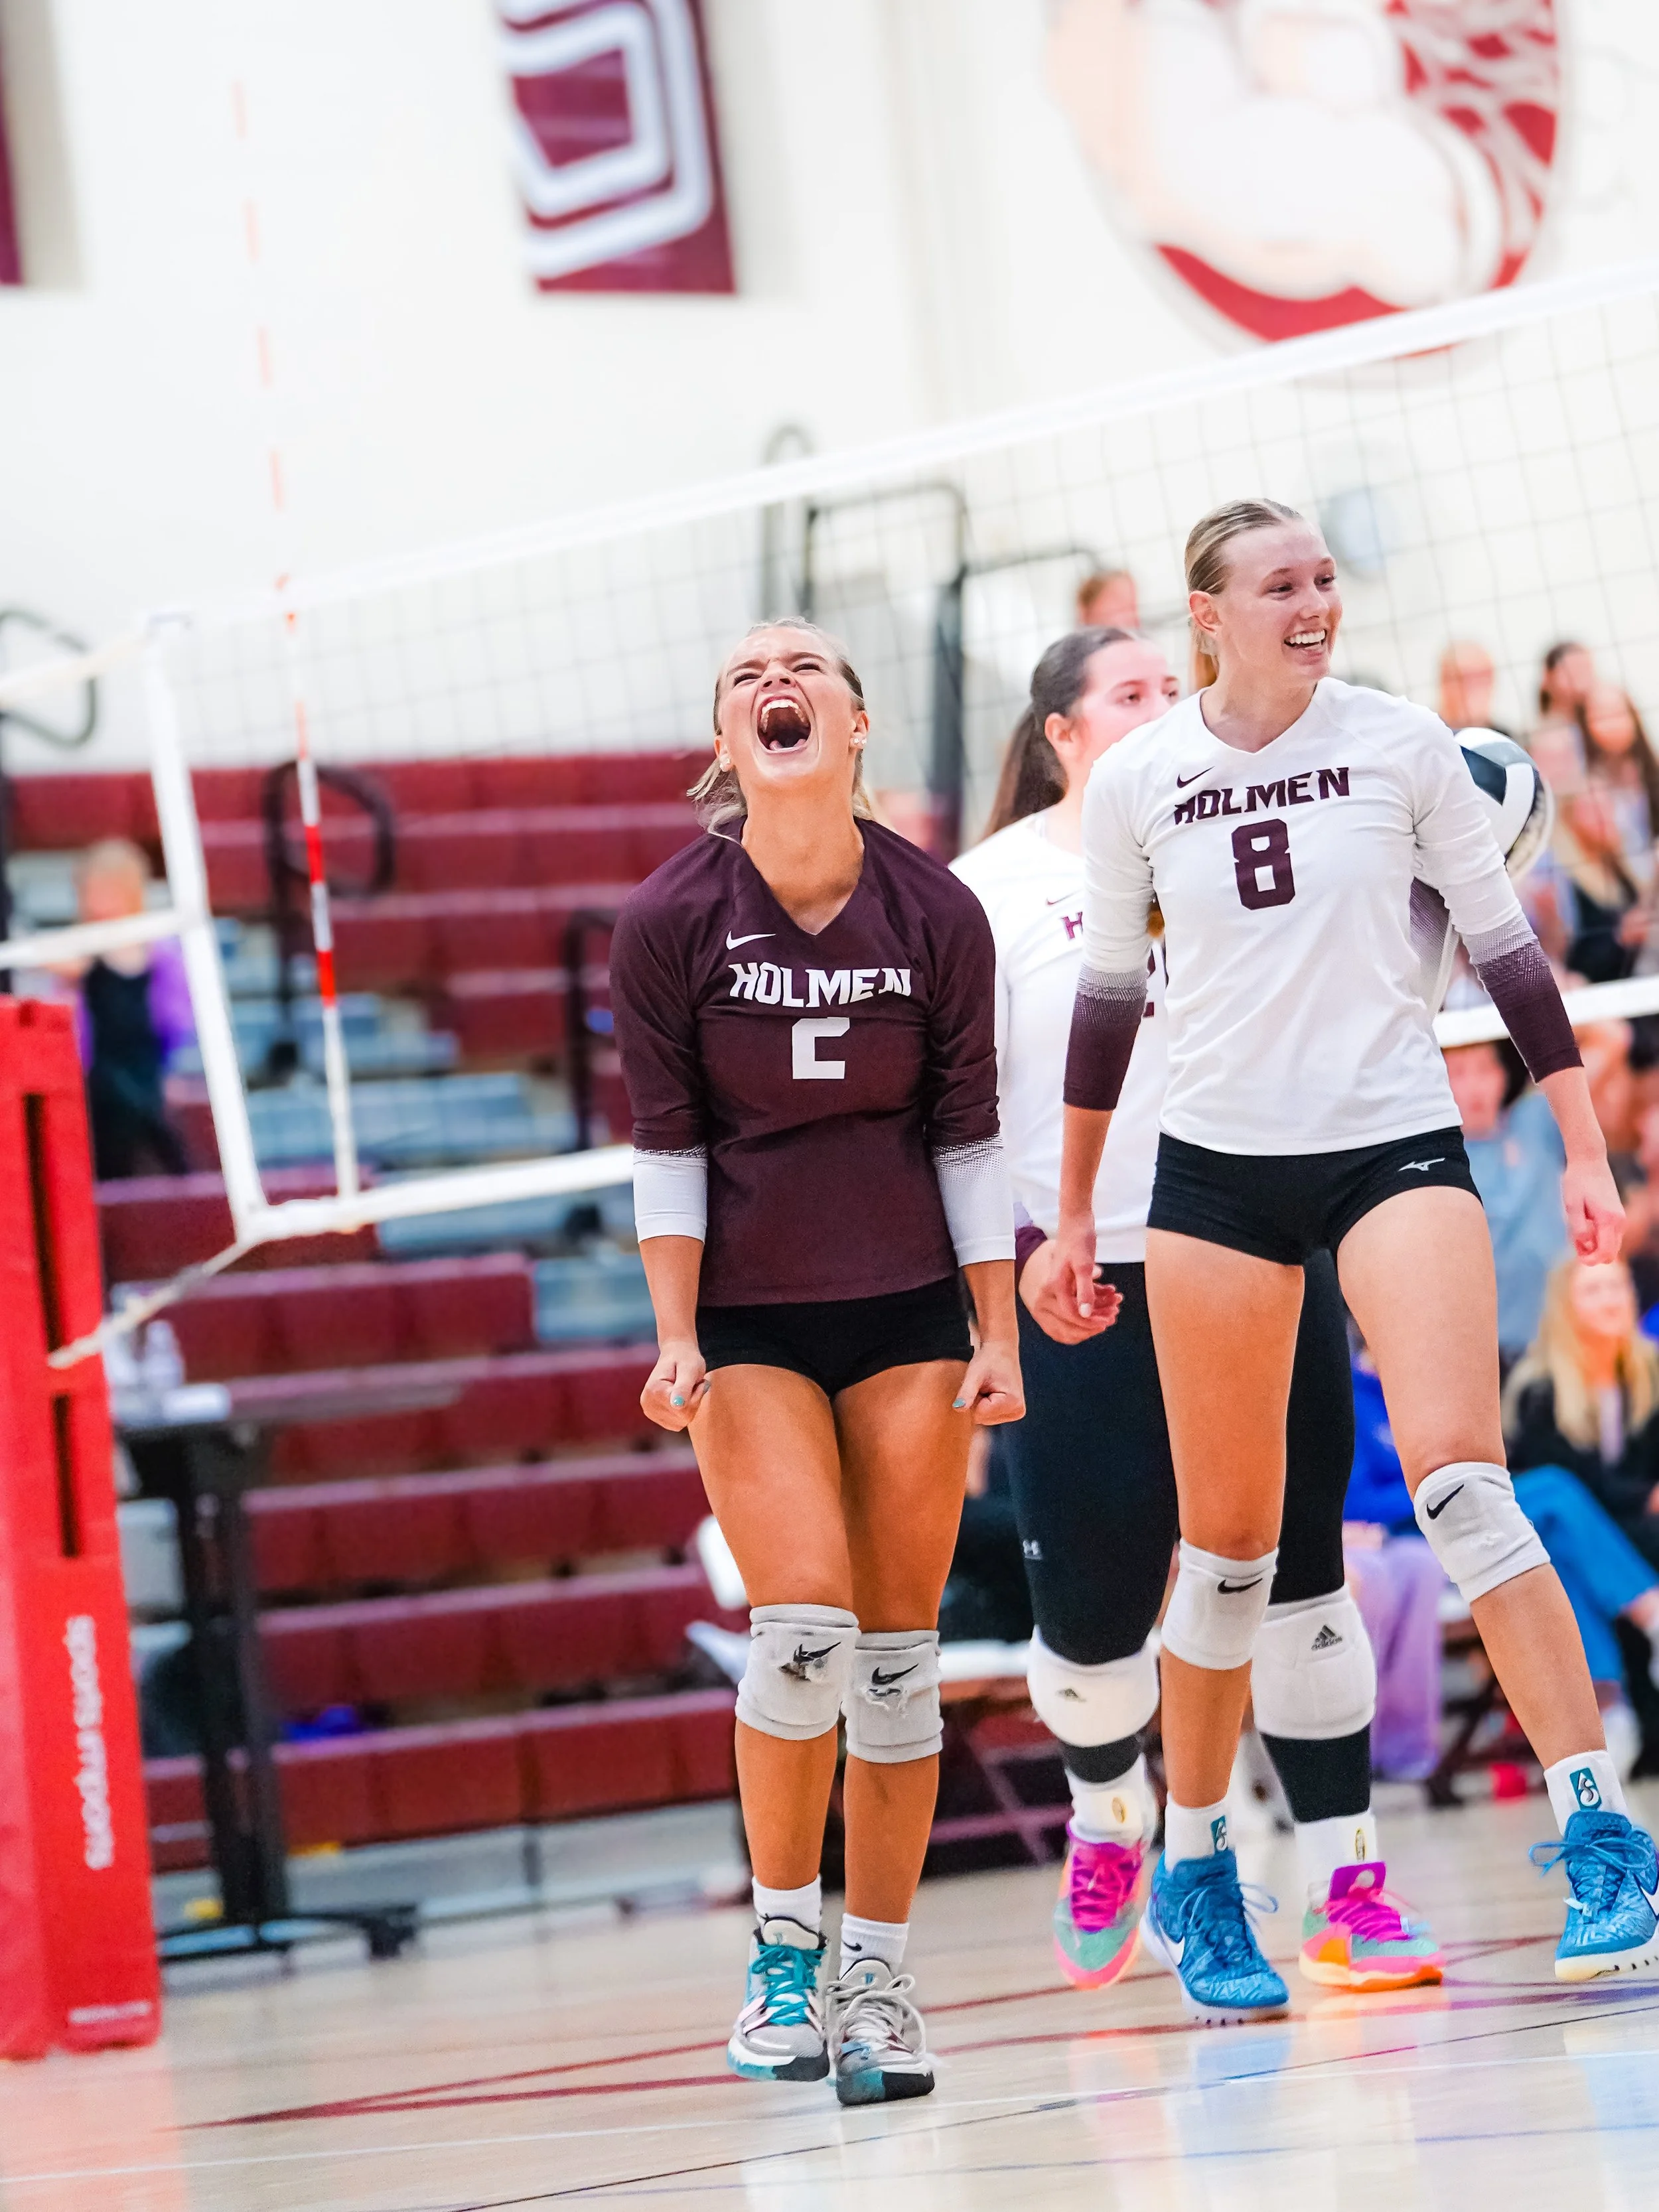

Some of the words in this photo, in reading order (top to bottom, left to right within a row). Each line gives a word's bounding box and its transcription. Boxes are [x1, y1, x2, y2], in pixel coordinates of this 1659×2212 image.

[1174, 767, 1350, 825] HOLMEN
[1231, 819, 1295, 910] 8
[728, 962, 911, 1007] HOLMEN
